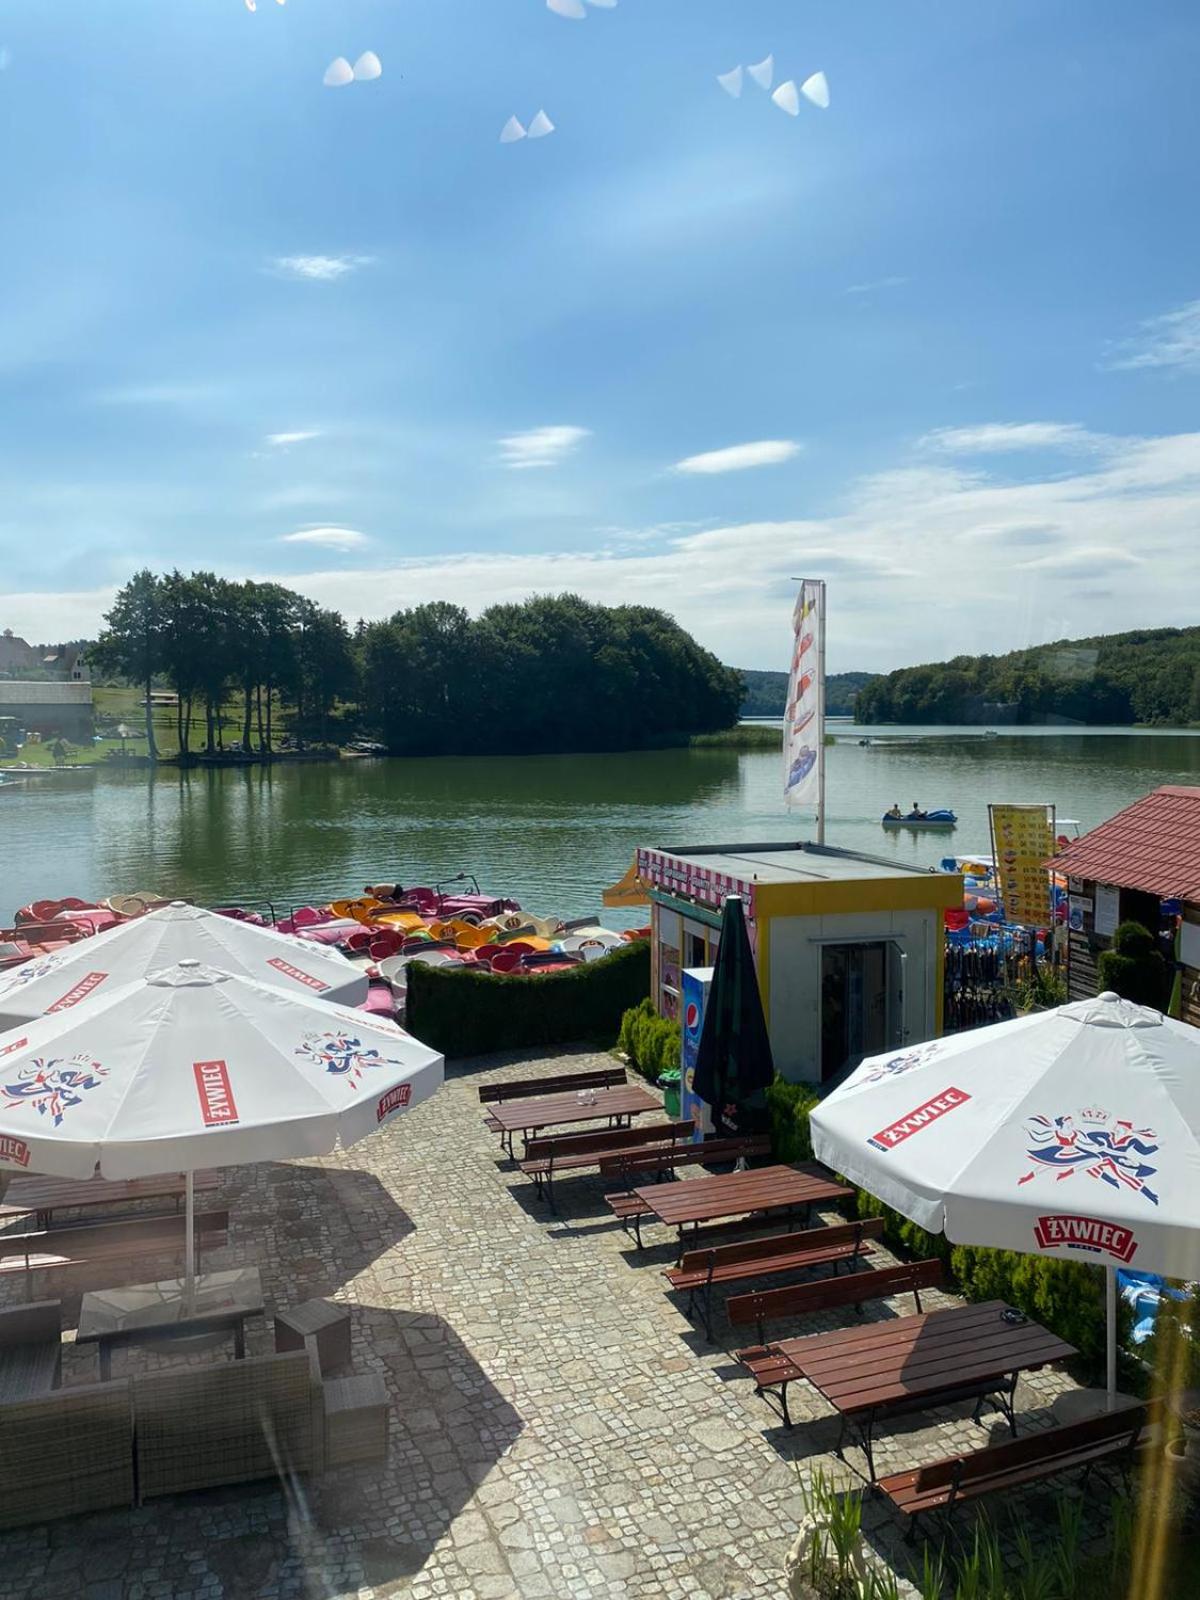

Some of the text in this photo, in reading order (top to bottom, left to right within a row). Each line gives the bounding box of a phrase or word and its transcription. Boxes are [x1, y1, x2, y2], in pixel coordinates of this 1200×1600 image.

[200, 1064, 231, 1119] ŻYWIEC
[882, 1092, 963, 1142] ŻYWIEC
[0, 1138, 23, 1157] IEC
[1047, 1217, 1125, 1249] ŻYWIEC
